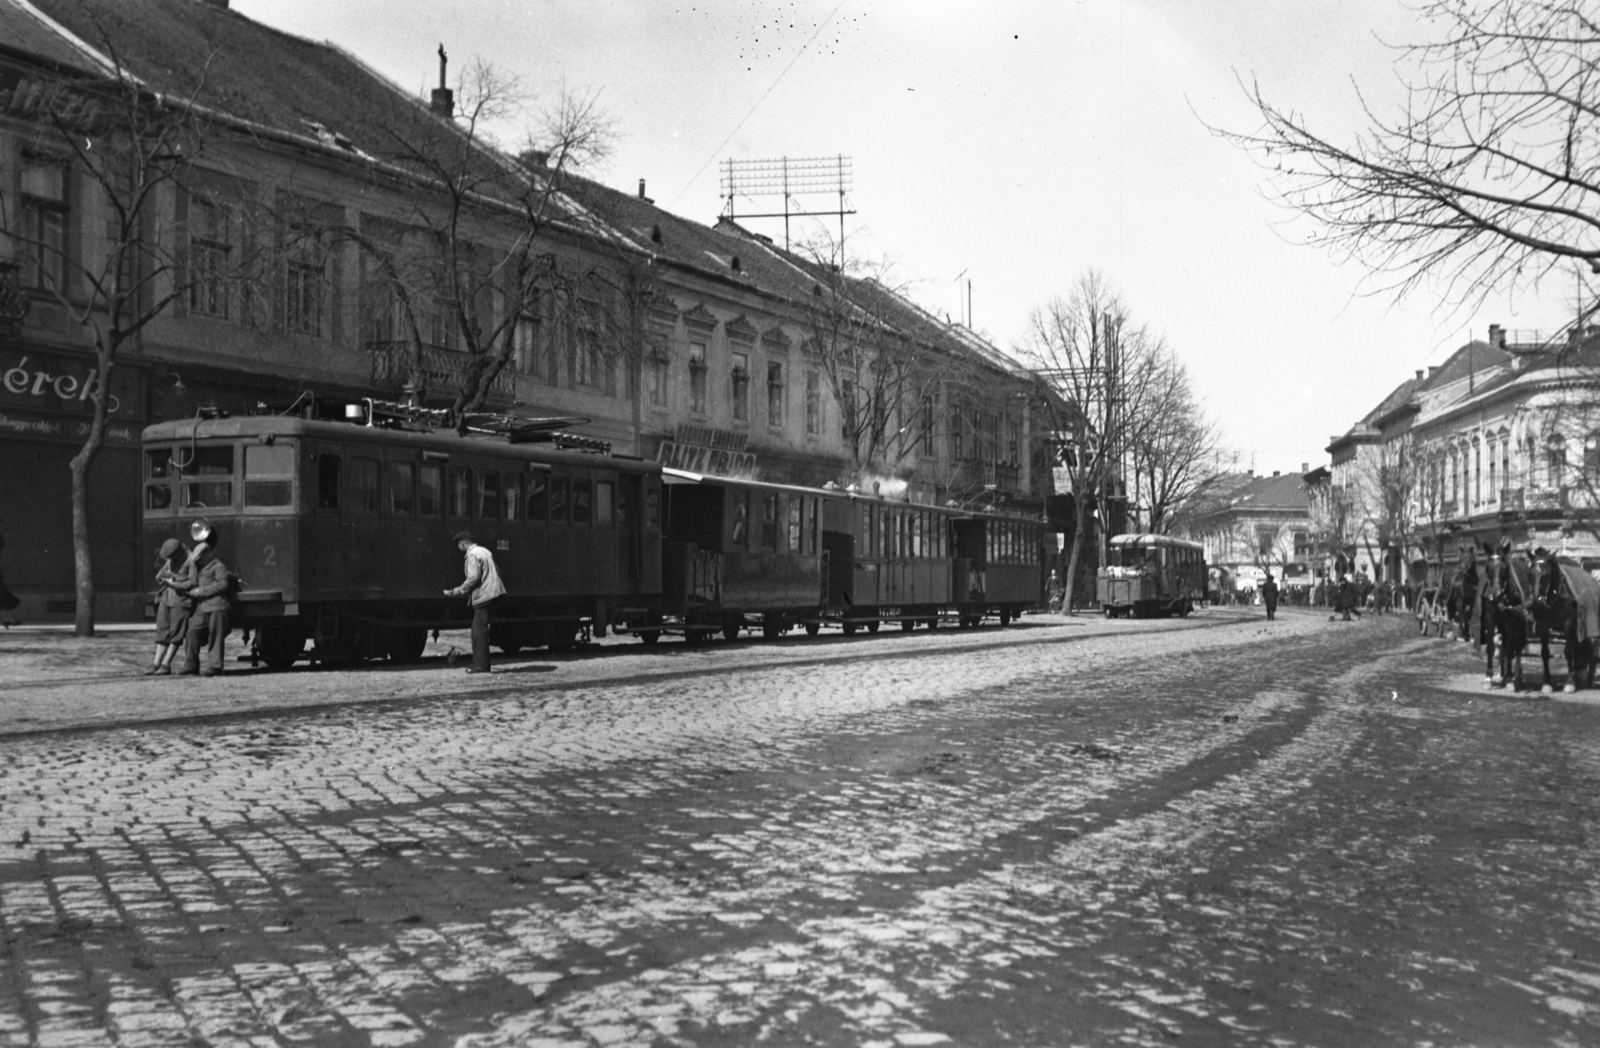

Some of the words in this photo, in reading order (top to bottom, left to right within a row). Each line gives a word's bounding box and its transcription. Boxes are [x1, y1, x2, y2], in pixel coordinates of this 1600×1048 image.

[0, 356, 119, 412] érek
[661, 442, 707, 471] BLITZ
[263, 545, 277, 566] 2
